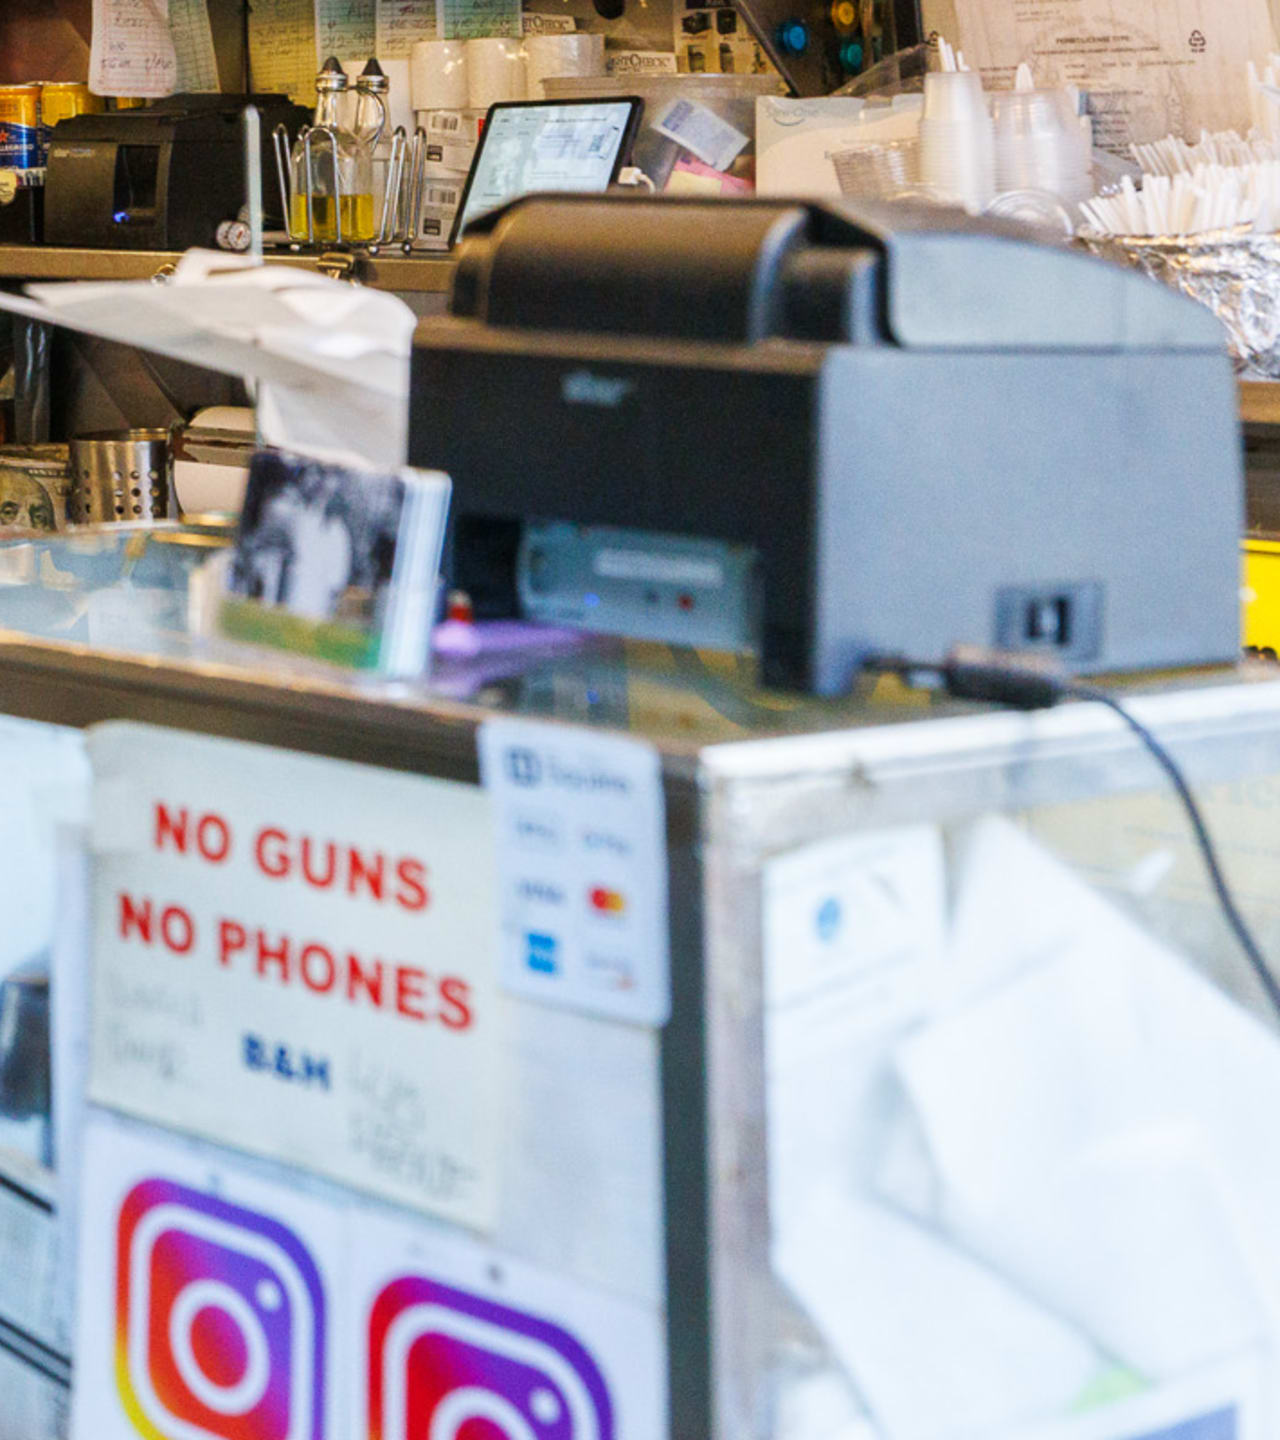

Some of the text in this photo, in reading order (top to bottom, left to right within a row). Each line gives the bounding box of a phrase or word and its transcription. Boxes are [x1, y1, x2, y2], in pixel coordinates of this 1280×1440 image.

[155, 803, 430, 914] NO GUNS
[117, 891, 474, 1033] NO PHONES
[243, 1031, 333, 1092] B&H
